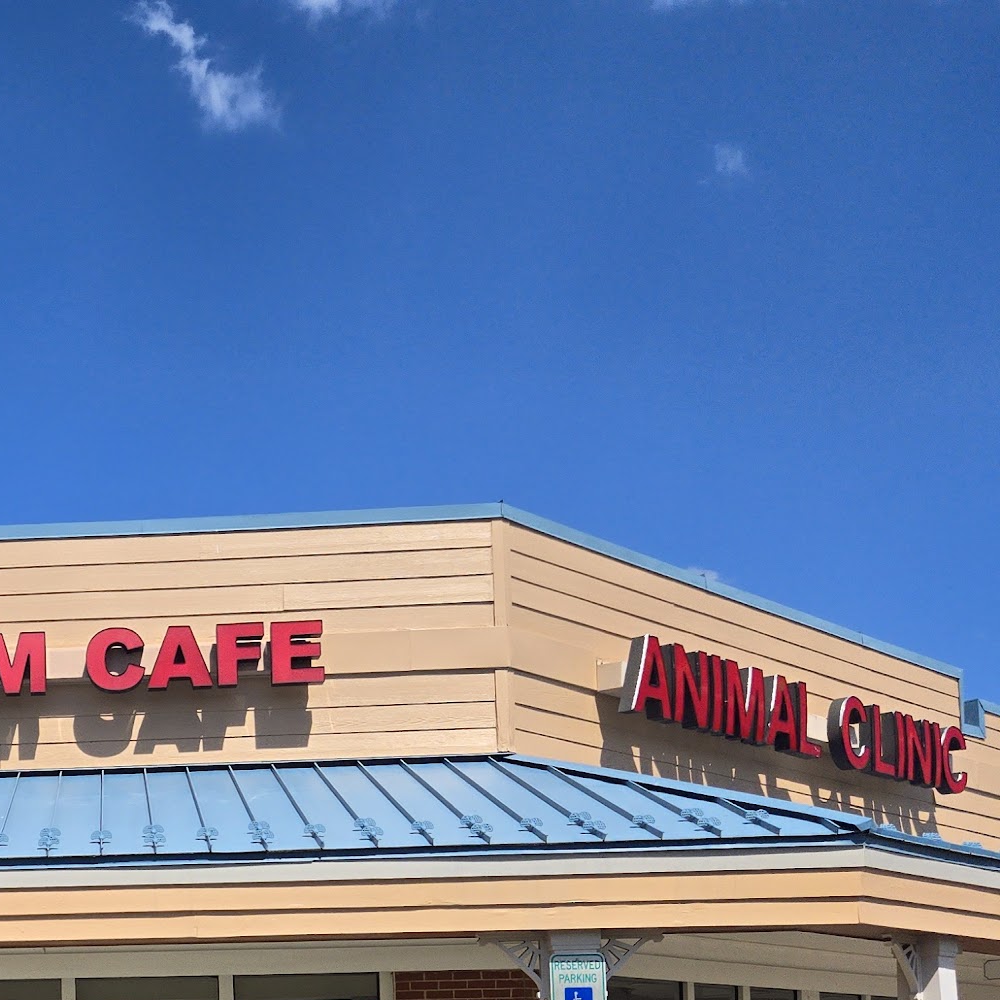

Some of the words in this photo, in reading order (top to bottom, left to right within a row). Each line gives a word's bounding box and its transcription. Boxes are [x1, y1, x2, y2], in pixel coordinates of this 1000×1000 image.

[85, 619, 326, 692] CAFE
[630, 634, 823, 758] ANIMAL
[836, 696, 968, 794] CLINIC
[554, 960, 601, 971] RESERVED
[559, 974, 598, 984] PARKING
